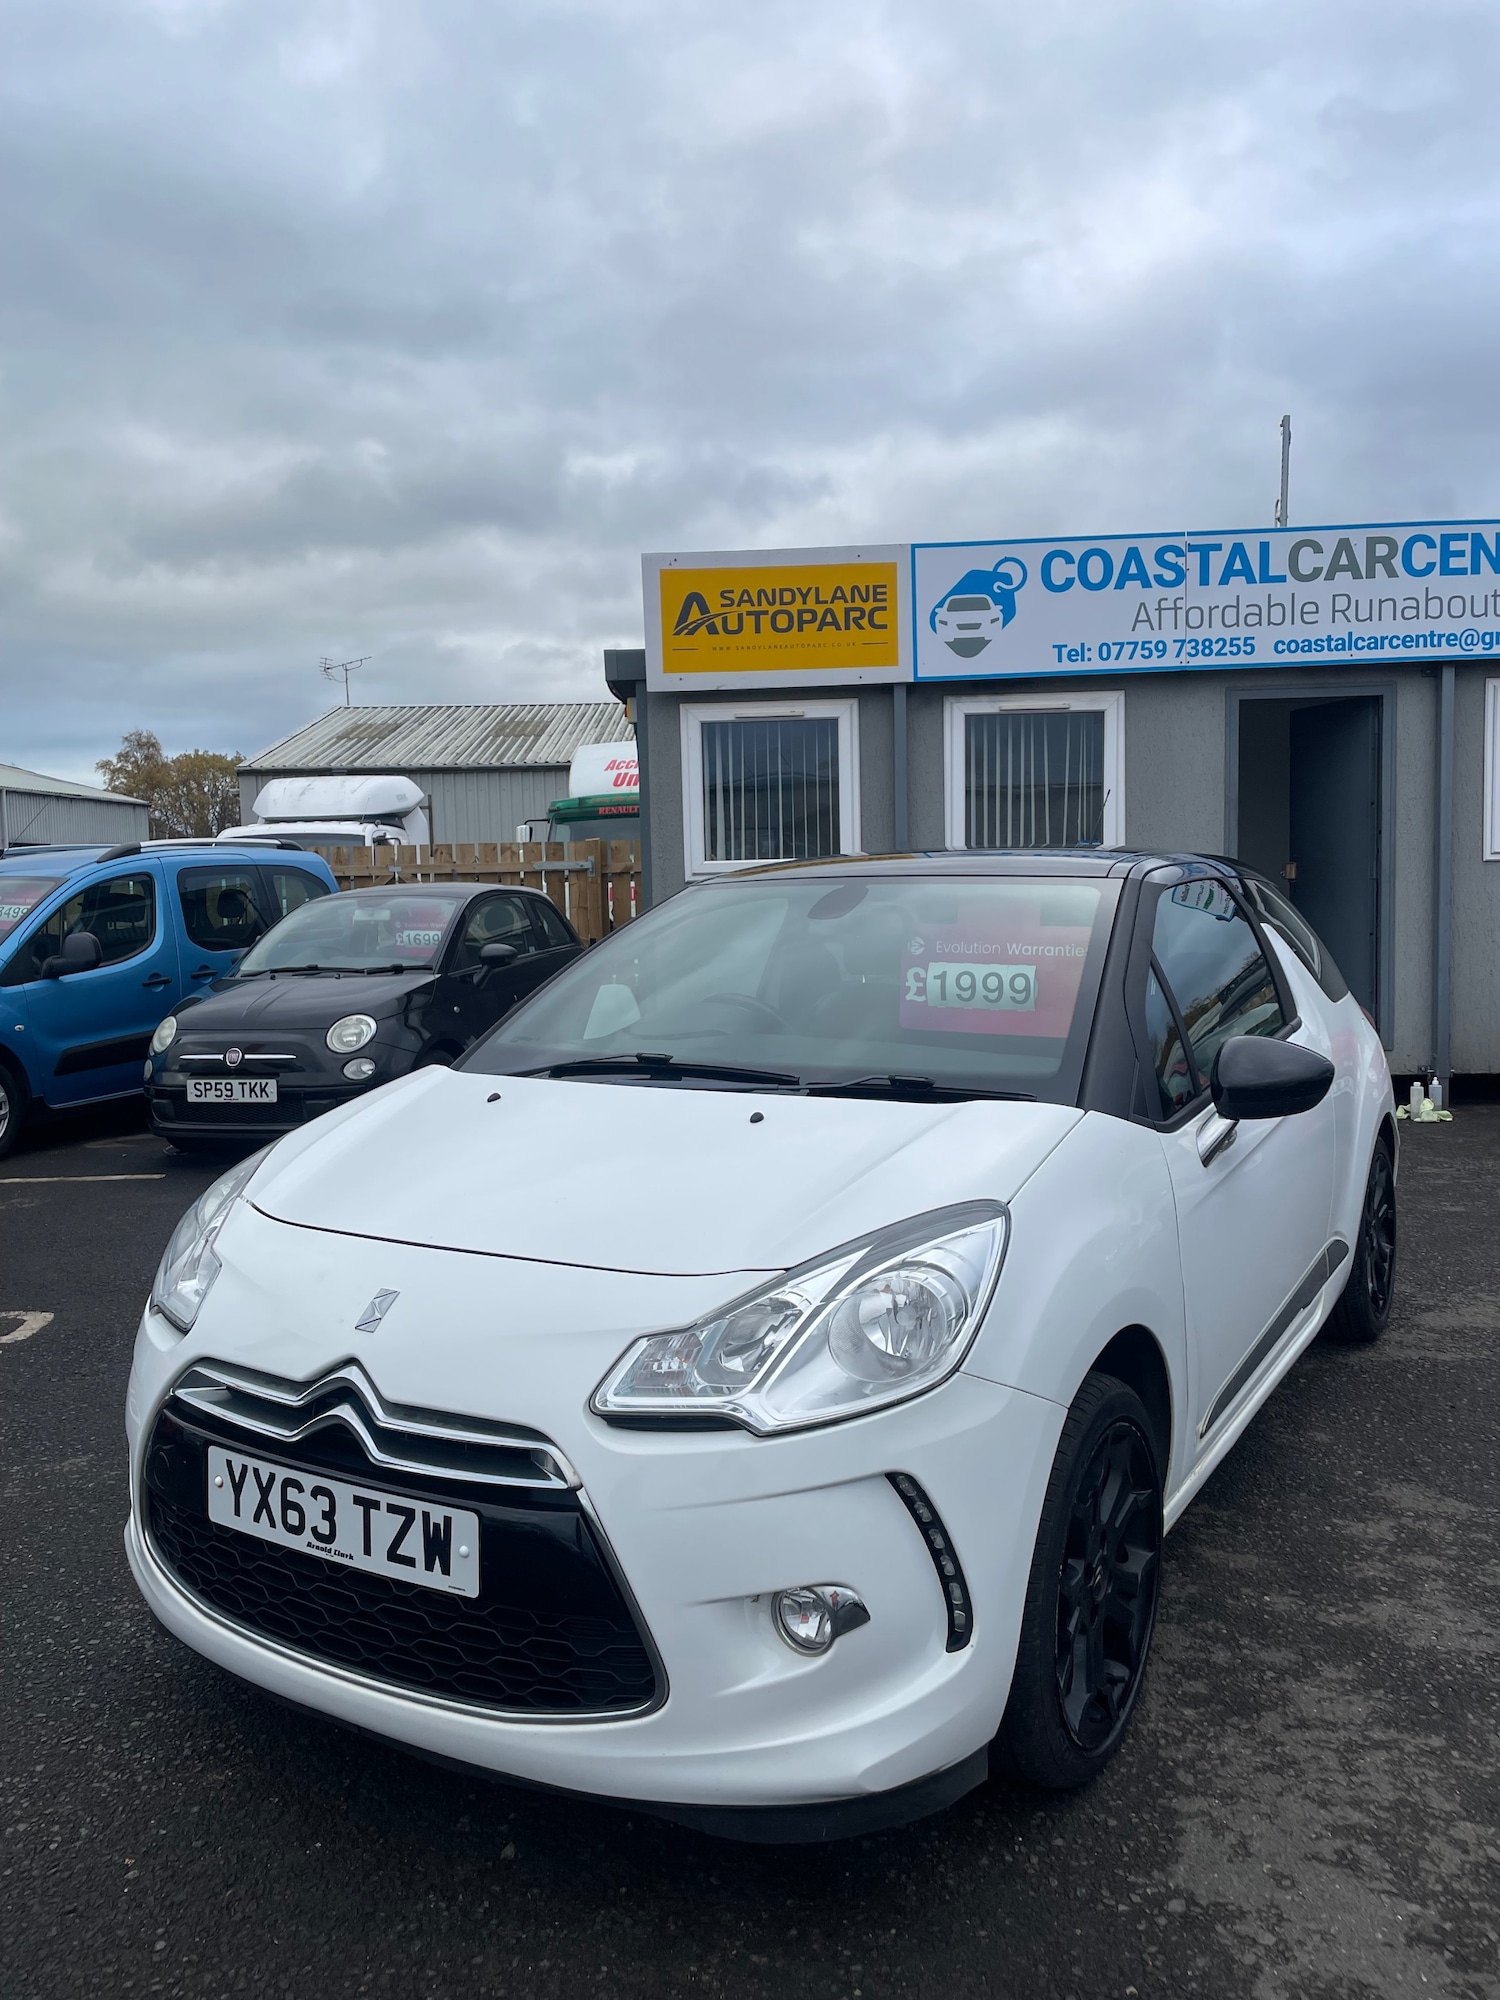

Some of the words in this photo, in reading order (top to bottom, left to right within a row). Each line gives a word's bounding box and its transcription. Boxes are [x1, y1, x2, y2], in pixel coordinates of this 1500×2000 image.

[719, 584, 888, 608] SANDYLANE
[672, 592, 888, 636] AUTOPARC
[1131, 592, 1320, 632] Affordable
[1331, 587, 1500, 624] Runabout
[1052, 642, 1092, 663] Tel:
[1098, 640, 1168, 661] 07759
[1173, 636, 1256, 658] 738255
[598, 805, 639, 814] RENAULT
[936, 940, 1001, 955] Evolution
[1006, 942, 1087, 957] Warrantie
[905, 966, 1032, 1005] £1999
[193, 1081, 234, 1098] SP59
[238, 1081, 270, 1098] TKK
[225, 1458, 337, 1545] YX63
[352, 1494, 453, 1577] TZW
[306, 1541, 332, 1554] Arnold
